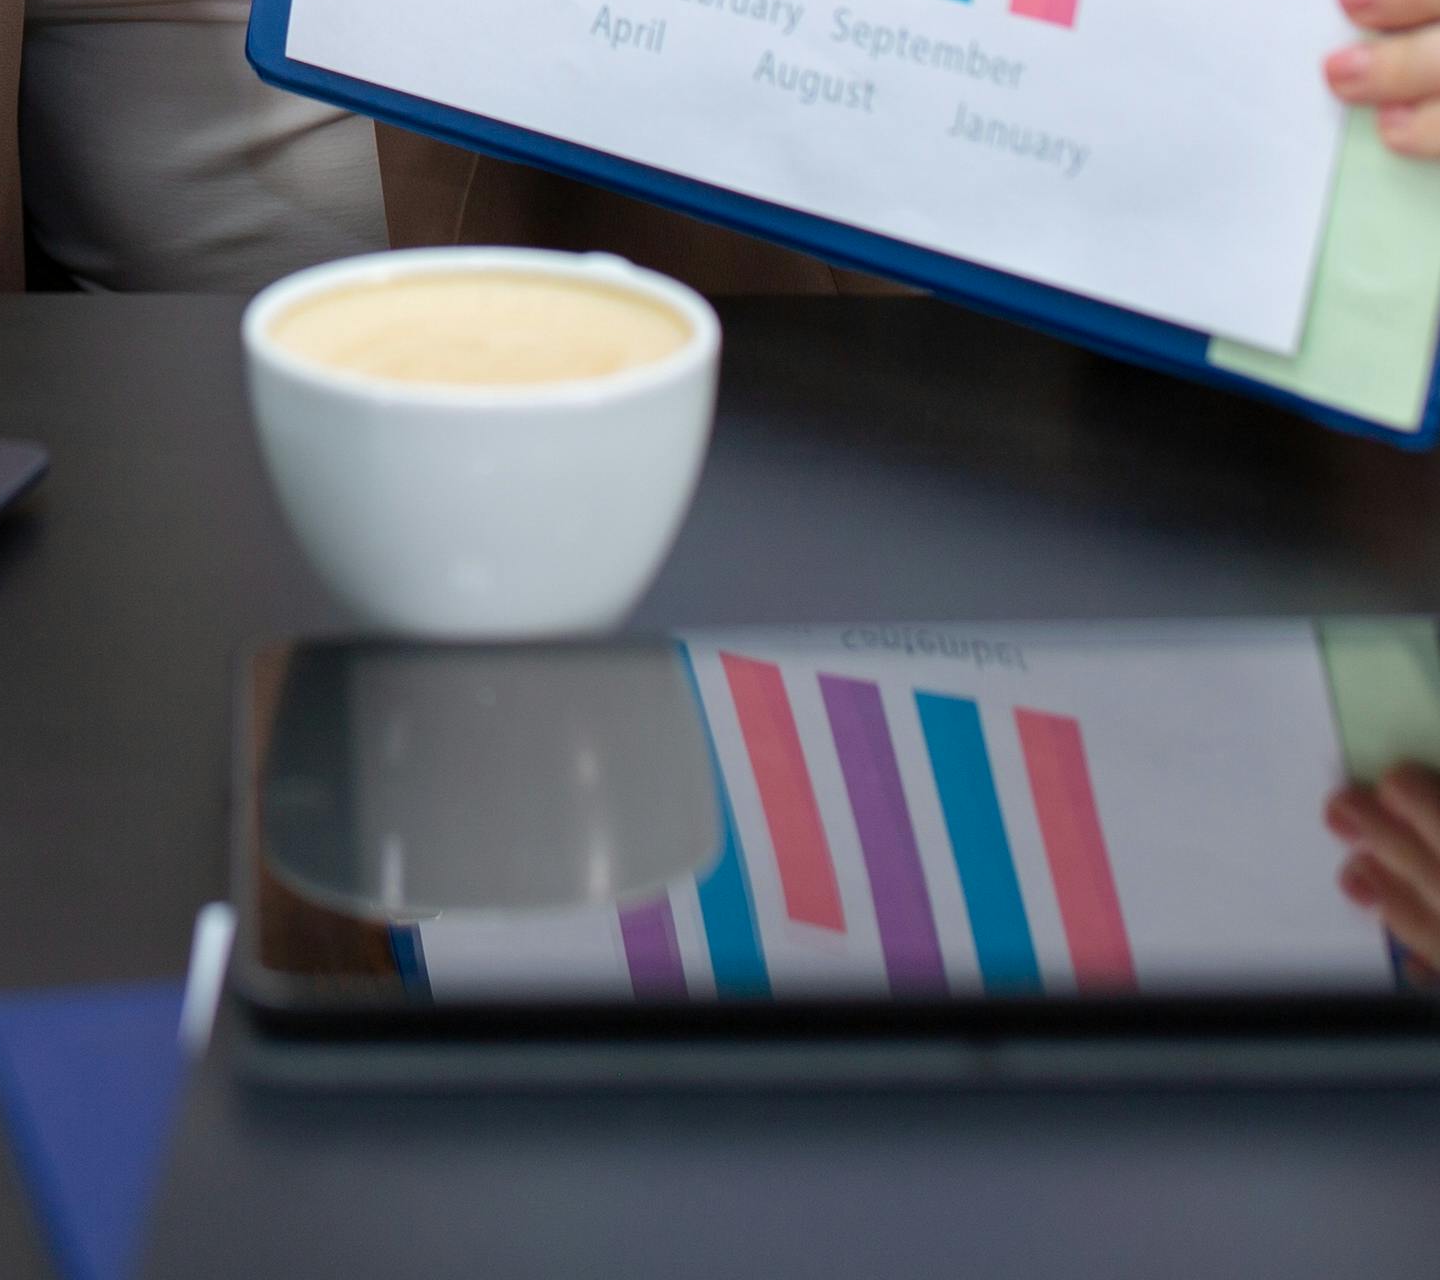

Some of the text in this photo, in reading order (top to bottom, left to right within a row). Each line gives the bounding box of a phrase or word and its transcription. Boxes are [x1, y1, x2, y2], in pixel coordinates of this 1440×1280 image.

[590, 4, 666, 53] April
[831, 7, 1027, 91] September
[752, 49, 878, 113] August
[947, 102, 1091, 177] January
